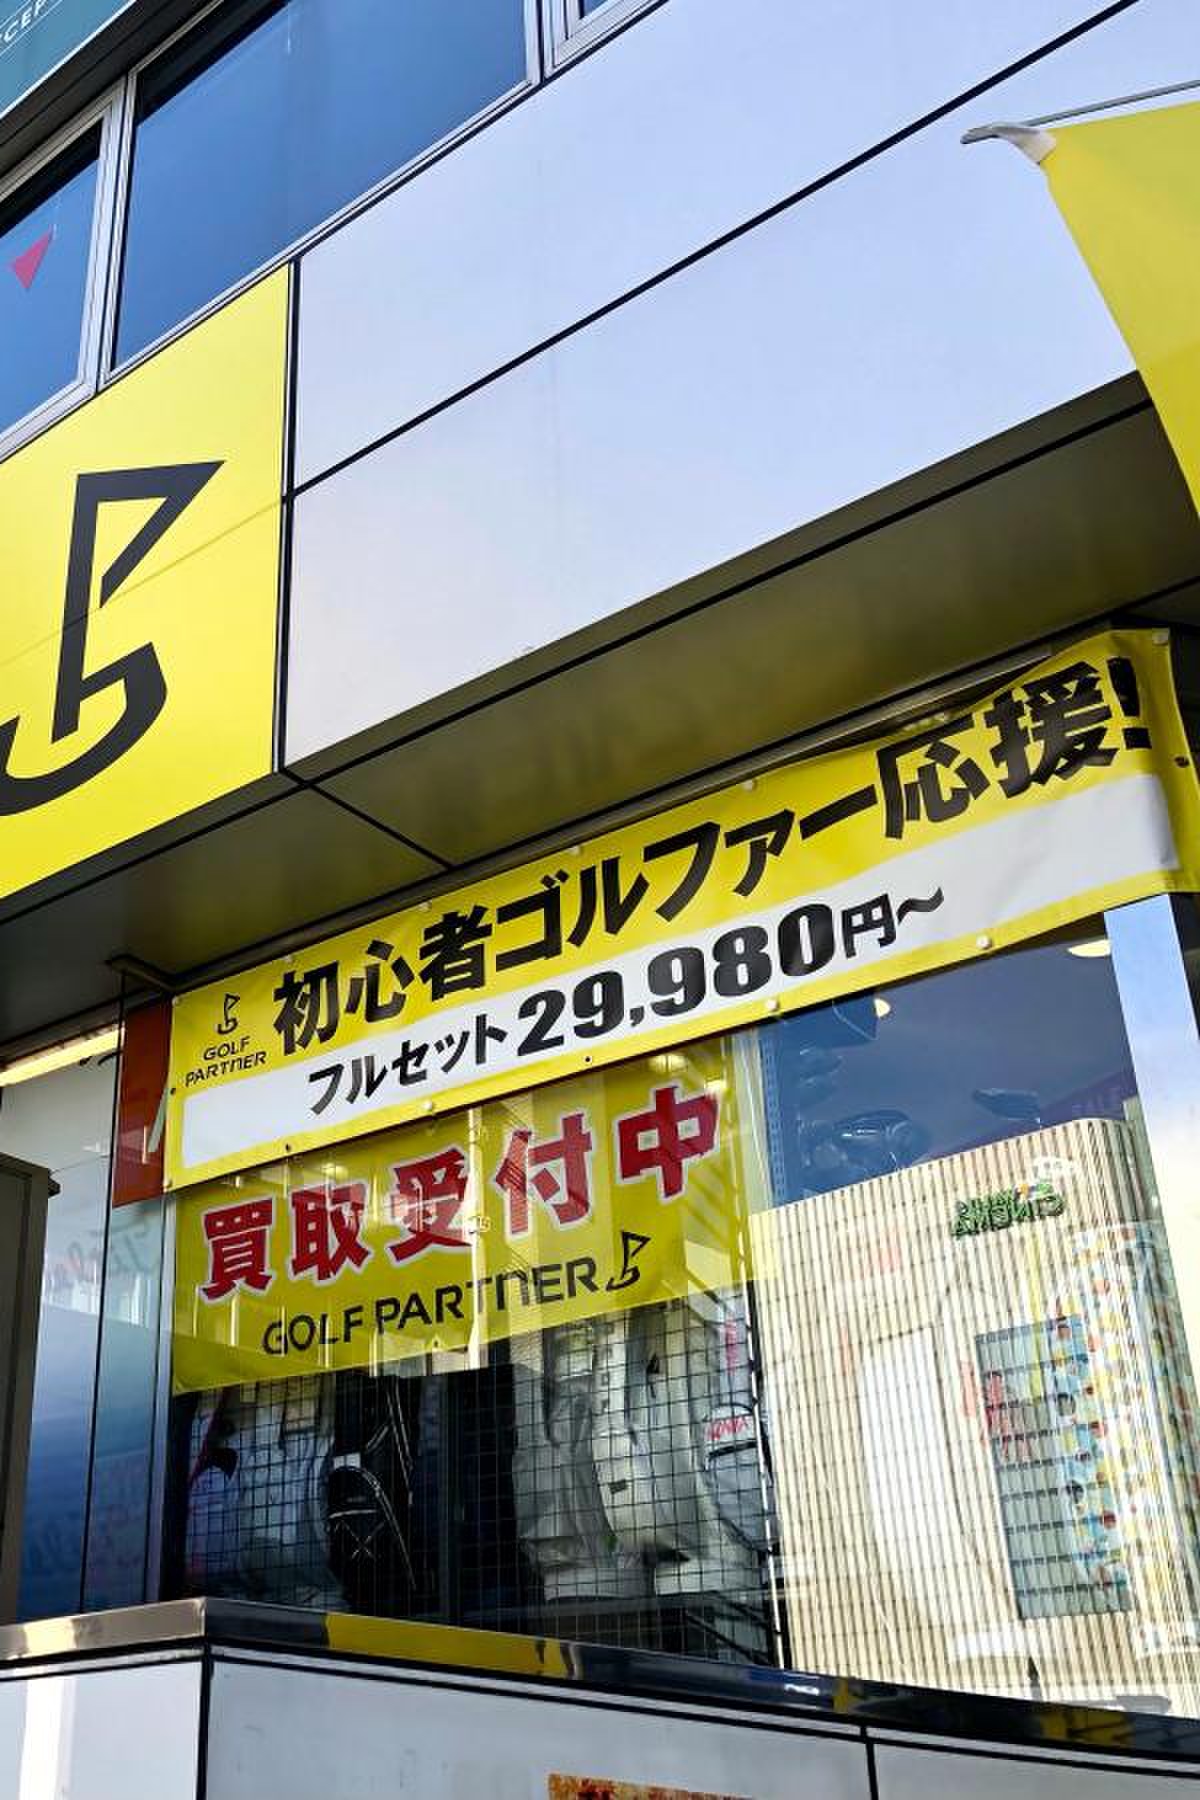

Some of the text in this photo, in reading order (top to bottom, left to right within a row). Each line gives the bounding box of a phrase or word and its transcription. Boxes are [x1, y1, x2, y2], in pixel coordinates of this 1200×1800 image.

[203, 1035, 251, 1061] GOLF
[201, 1085, 720, 1301] 買取受付中
[262, 1304, 364, 1356] GOLF
